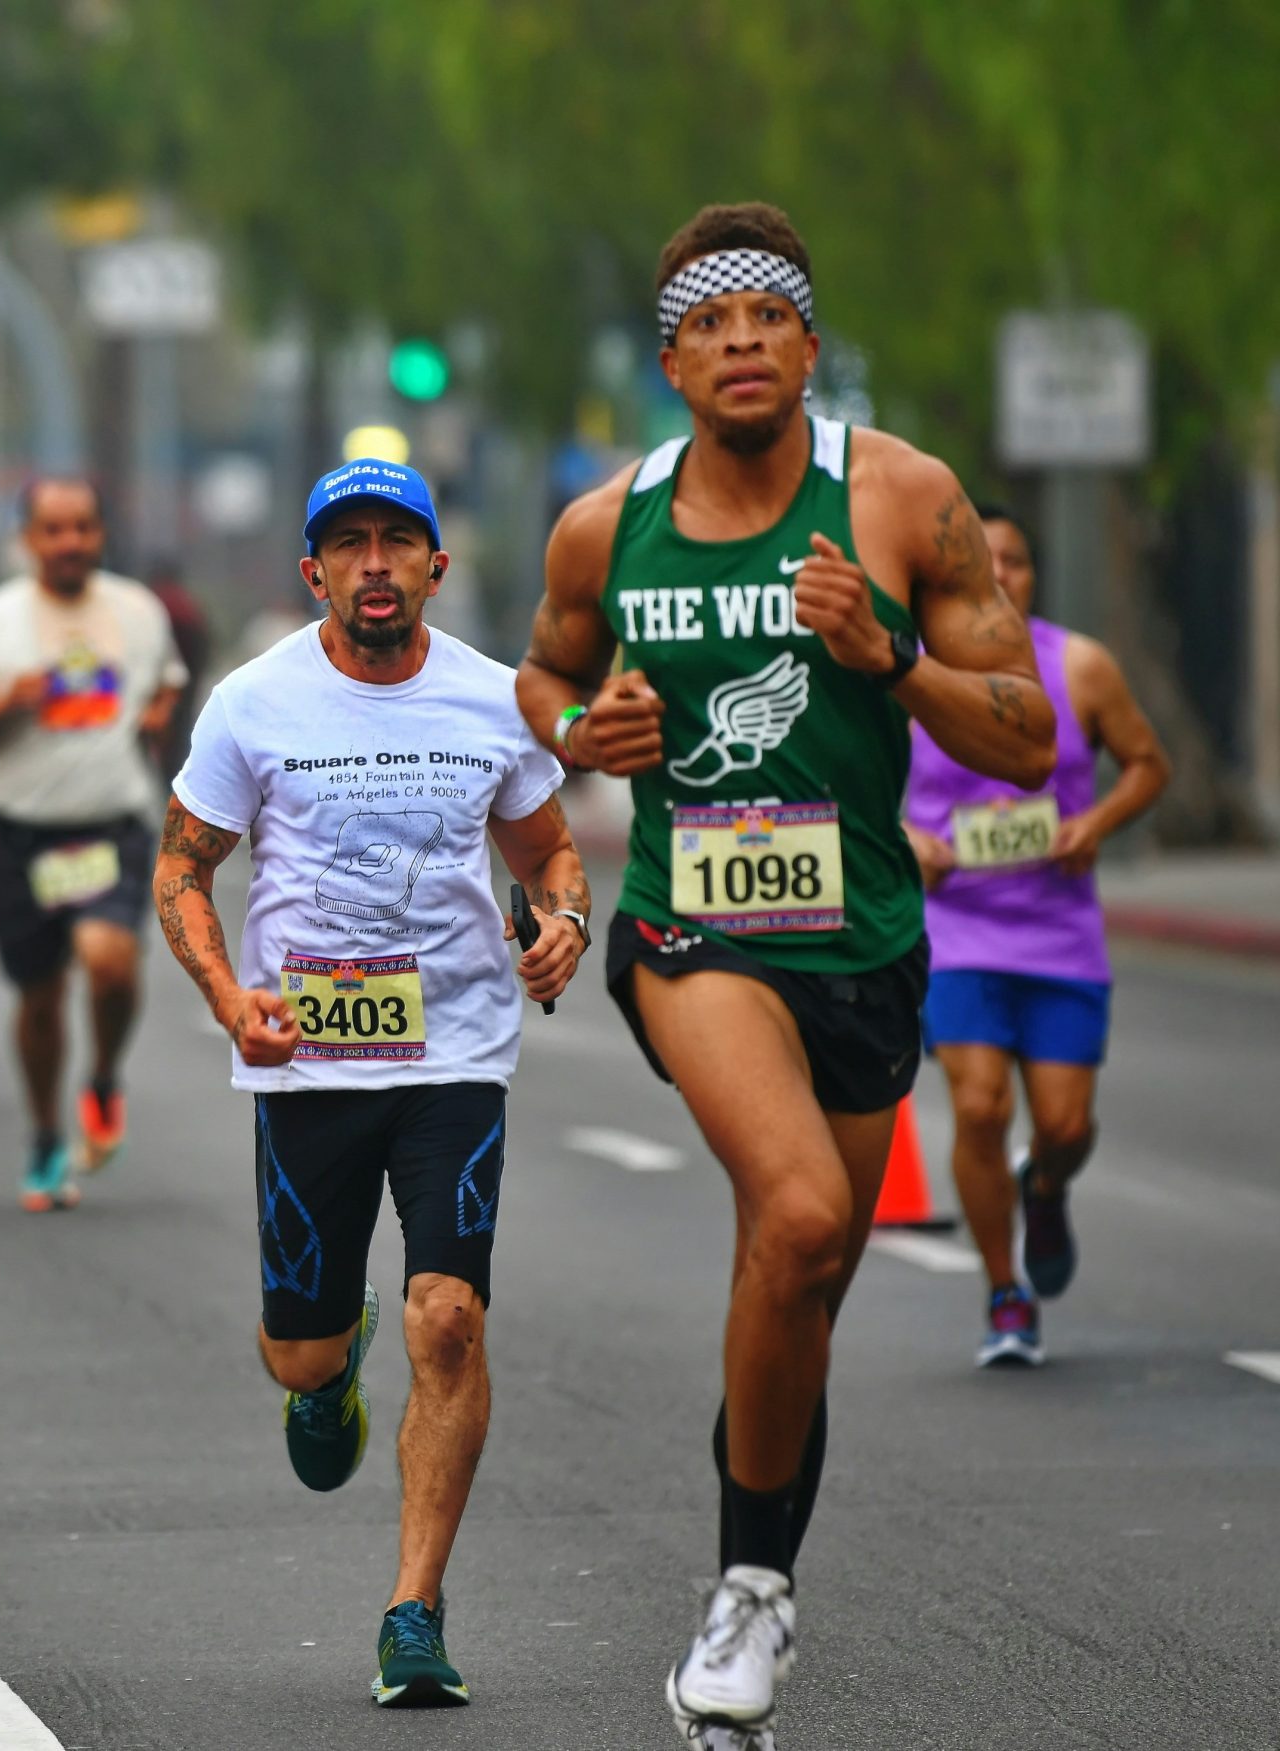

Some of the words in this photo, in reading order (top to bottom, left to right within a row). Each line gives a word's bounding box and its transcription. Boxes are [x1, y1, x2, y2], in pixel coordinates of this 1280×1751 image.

[323, 465, 380, 491] Bonitas
[382, 467, 408, 481] ten
[366, 483, 403, 495] man
[618, 587, 704, 643] THE
[283, 755, 368, 773] Square
[375, 752, 420, 765] One
[429, 751, 494, 773] Dining
[328, 773, 359, 785] 4854
[365, 771, 425, 783] Fountain
[432, 773, 457, 782] Ave
[317, 790, 339, 802] Los
[345, 788, 399, 803] Angeles
[404, 786, 424, 798] CA
[430, 786, 467, 800] 90029
[967, 816, 1050, 859] 1620
[693, 853, 823, 906] 1098
[326, 922, 345, 933] Best
[348, 926, 381, 935] French
[386, 926, 410, 935] Toast
[298, 995, 408, 1037] 3403
[343, 1049, 365, 1058] 2021
